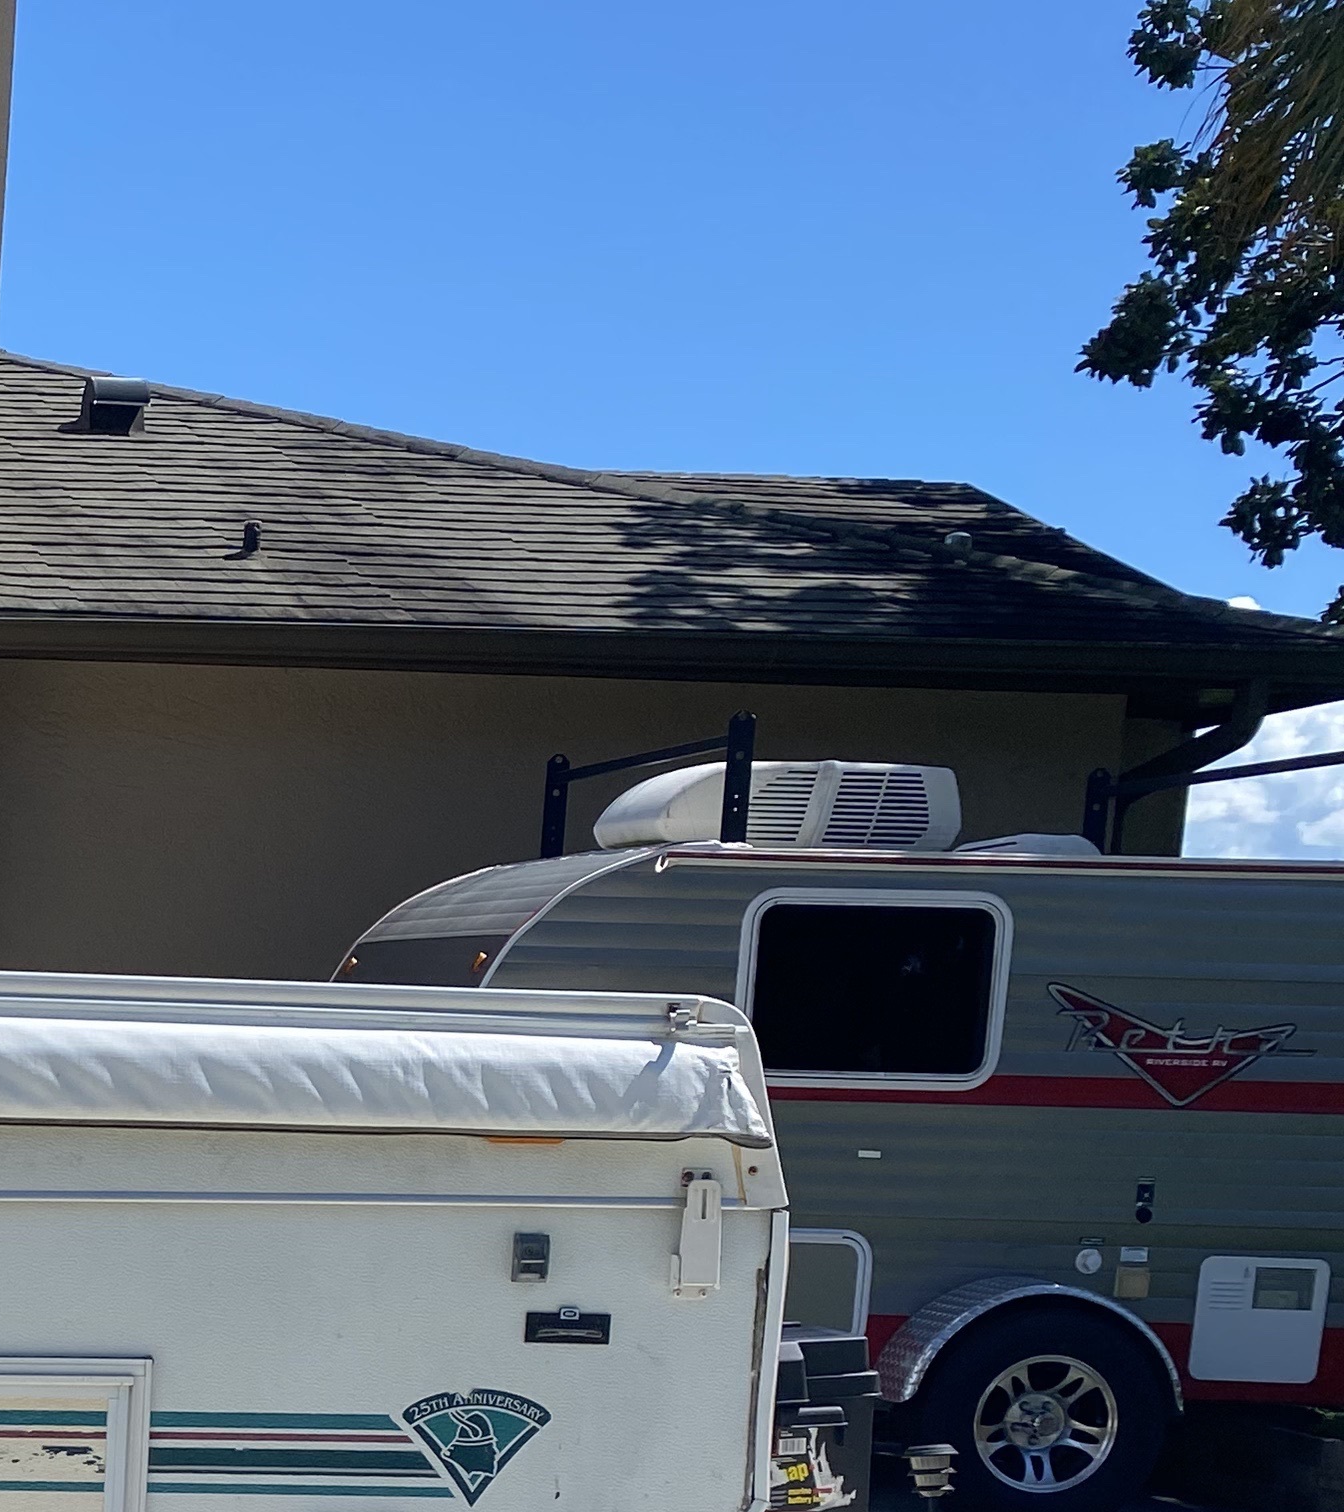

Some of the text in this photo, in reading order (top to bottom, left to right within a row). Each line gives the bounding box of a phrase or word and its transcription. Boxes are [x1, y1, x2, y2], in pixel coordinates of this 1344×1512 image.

[1145, 1058, 1228, 1068] RIVERSIDE RV
[409, 1397, 448, 1420] 25TH
